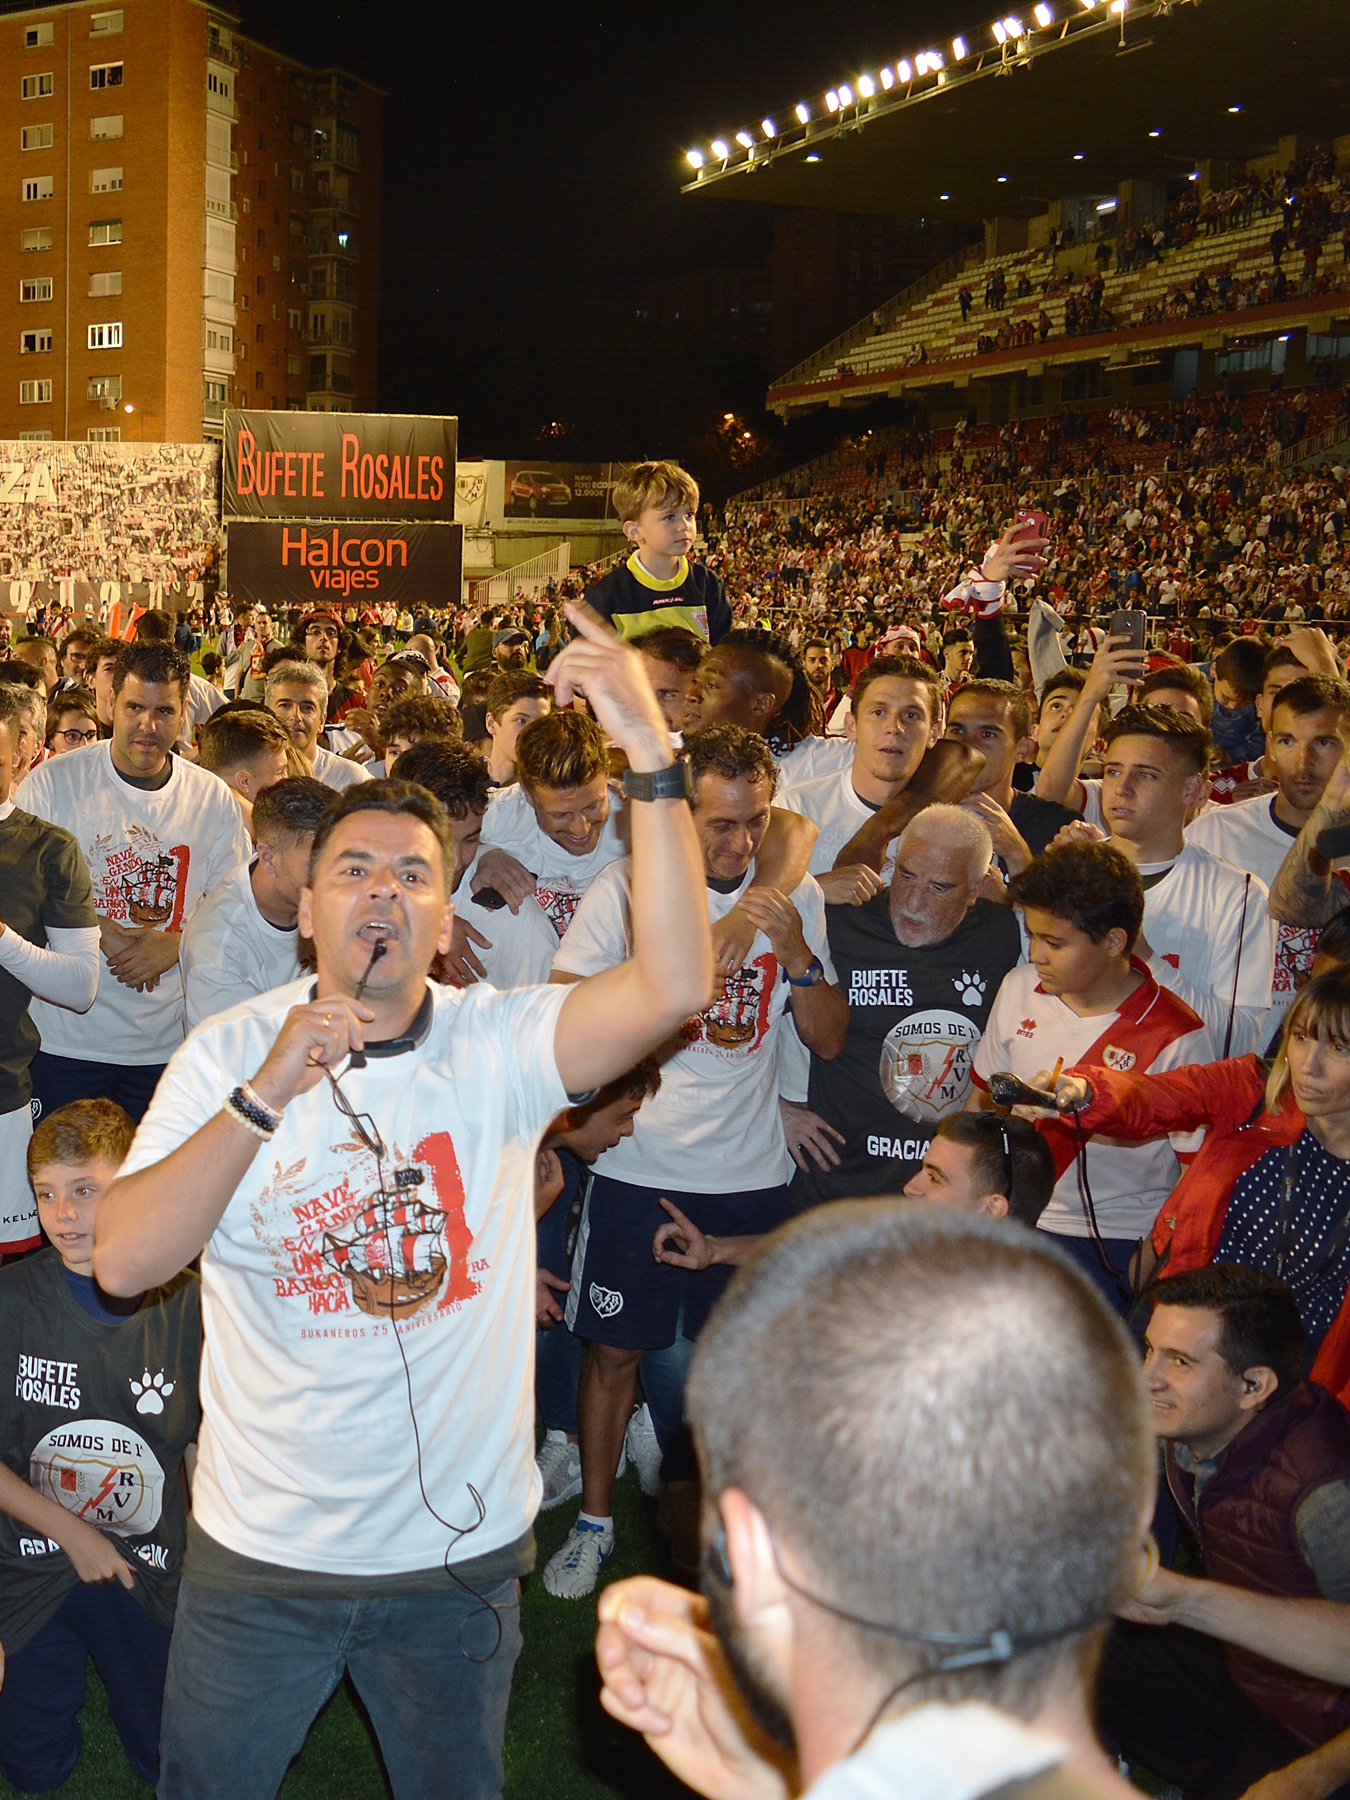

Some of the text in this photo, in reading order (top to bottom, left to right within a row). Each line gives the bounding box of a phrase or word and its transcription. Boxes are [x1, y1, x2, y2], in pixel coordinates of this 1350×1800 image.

[237, 430, 444, 501] BUFETE ROSALES
[281, 528, 407, 567] Halcon
[310, 569, 380, 597] viajes
[109, 857, 143, 877] GANDO
[102, 877, 118, 885] EN
[105, 885, 120, 898] UN
[851, 969, 908, 988] BUFETE
[848, 988, 914, 1007] ROSALES
[894, 1022, 941, 1038] SOMOS
[948, 1023, 967, 1037] DE
[866, 1134, 932, 1160] GRACIA
[283, 1236, 318, 1252] EN
[291, 1249, 325, 1275] UN
[470, 1257, 491, 1274] RA
[300, 1302, 464, 1339] BUKANEROS 25 ANIVERSARIO
[18, 1353, 79, 1386] BUFETE
[14, 1374, 81, 1410] ROSALES
[48, 1433, 105, 1452] SOMOS
[111, 1438, 132, 1455] DE
